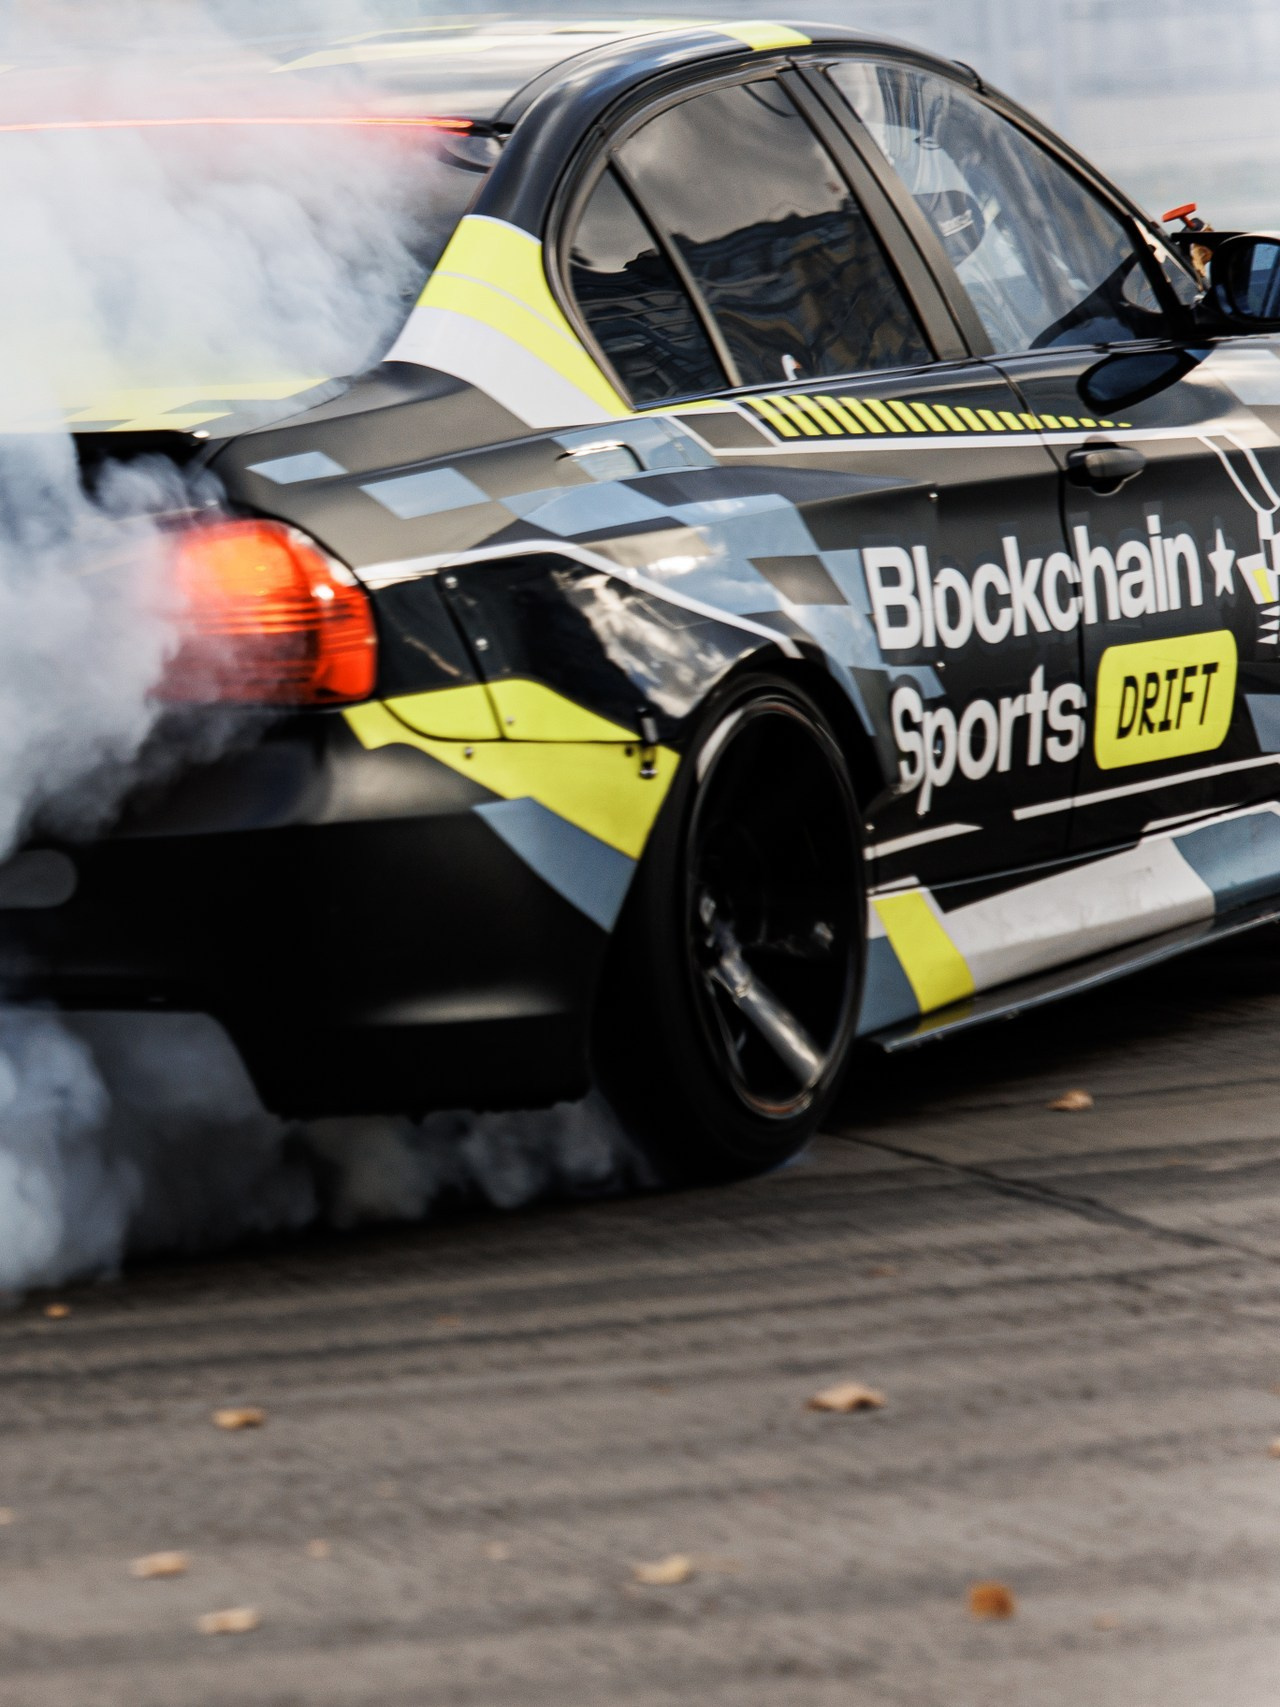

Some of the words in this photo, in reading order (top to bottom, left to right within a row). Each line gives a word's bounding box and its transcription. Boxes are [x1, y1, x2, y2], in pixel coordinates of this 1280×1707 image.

[862, 514, 1203, 649] Blockchain
[891, 665, 1086, 815] Sports
[1116, 662, 1219, 739] DRIFT
